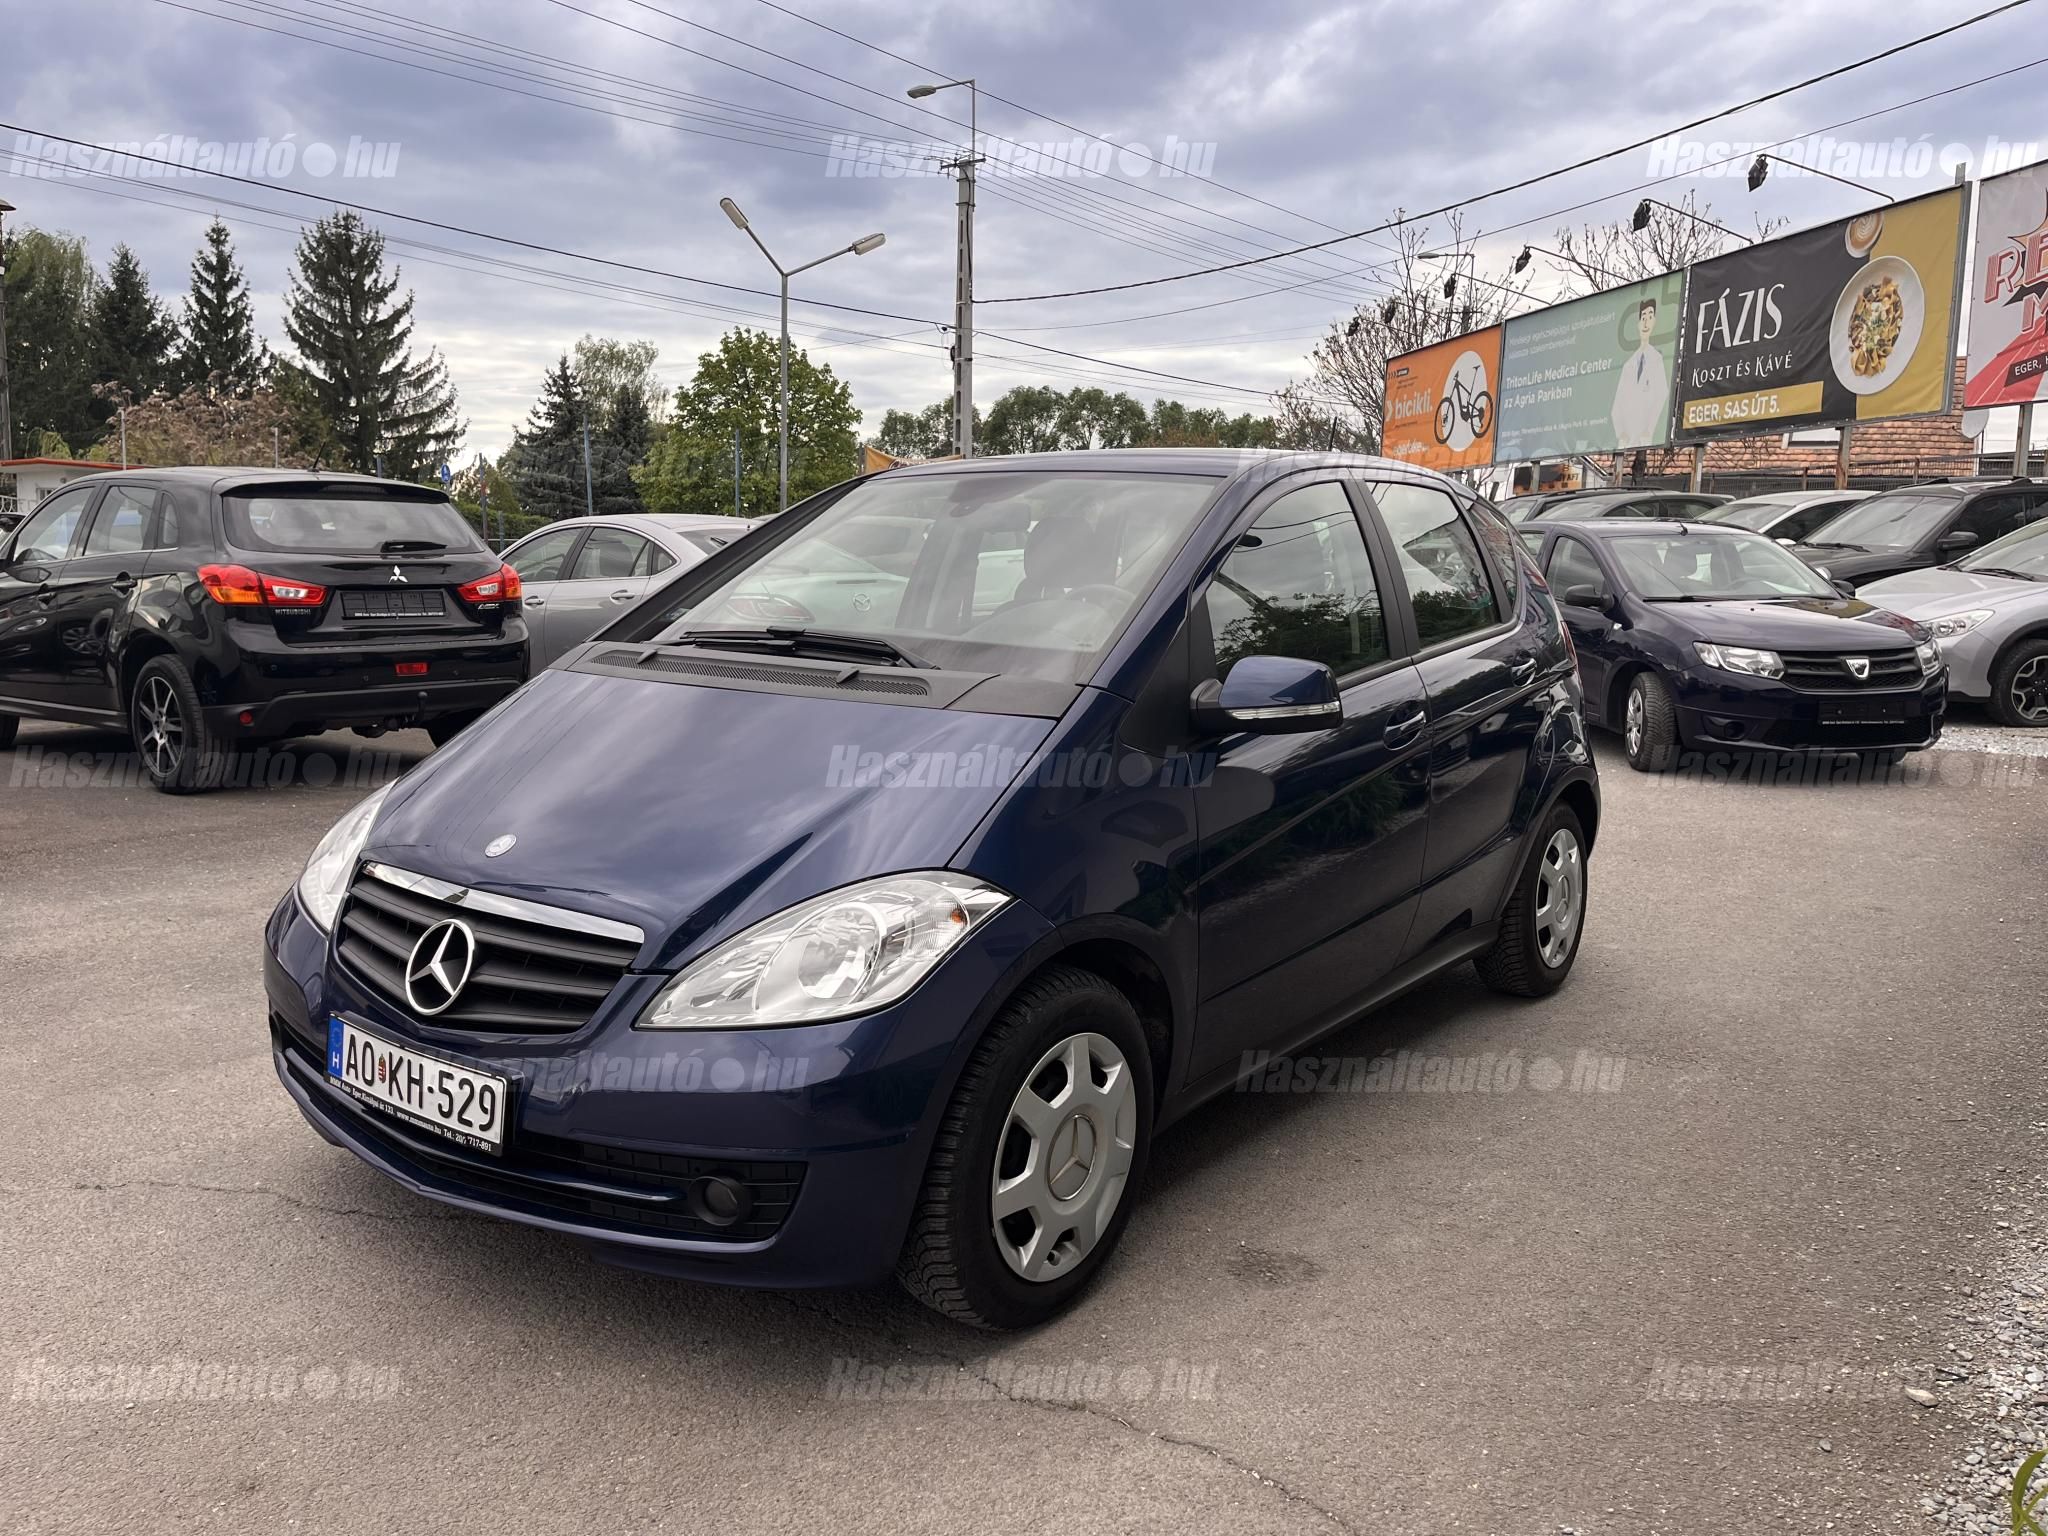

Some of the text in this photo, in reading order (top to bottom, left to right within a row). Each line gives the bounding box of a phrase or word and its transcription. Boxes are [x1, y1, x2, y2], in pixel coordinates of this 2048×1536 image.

[1695, 283, 1785, 354] FÁZIS
[1506, 358, 1612, 389] TritonLife Medical Center
[1691, 350, 1793, 388] KOSZT ÉS KÁVÉ
[2015, 359, 2042, 376] EGER,
[1395, 388, 1433, 417] bicikli.
[1514, 393, 1535, 408] Agria
[1537, 386, 1572, 402] Parkban
[1688, 402, 1722, 424] EGER,
[1723, 399, 1749, 419] SAS
